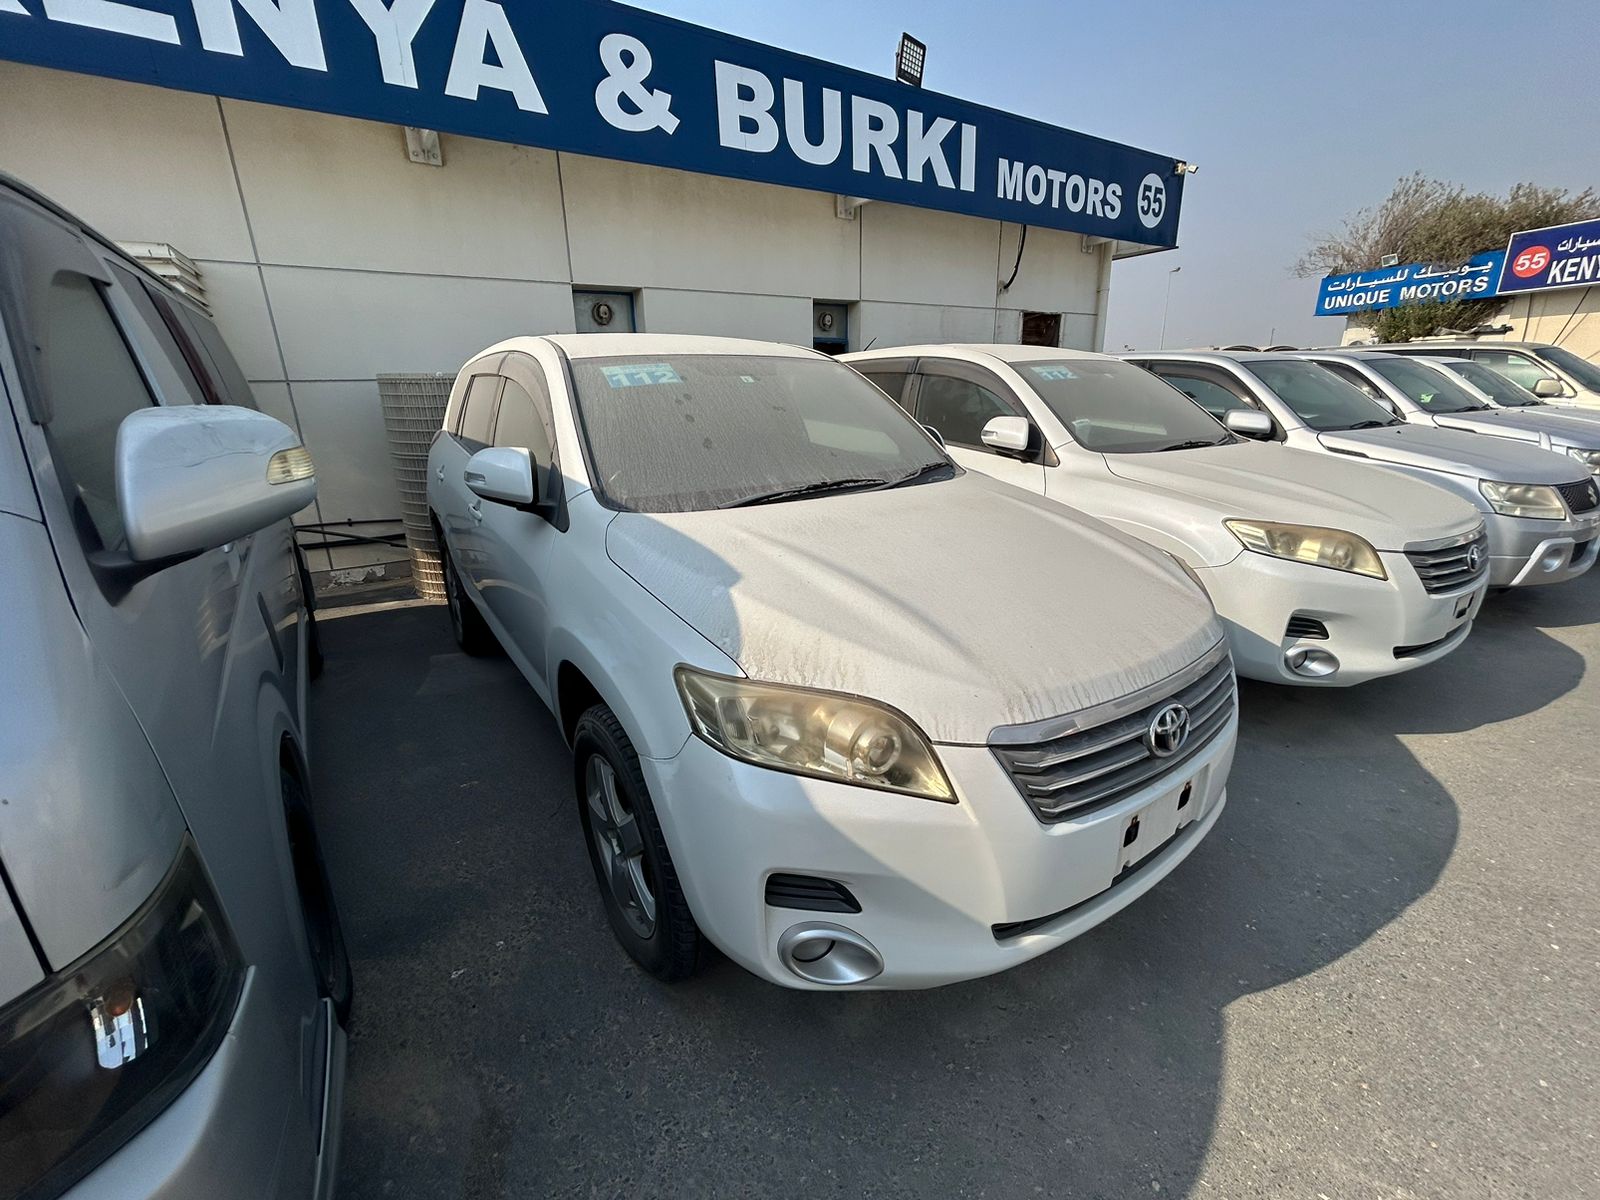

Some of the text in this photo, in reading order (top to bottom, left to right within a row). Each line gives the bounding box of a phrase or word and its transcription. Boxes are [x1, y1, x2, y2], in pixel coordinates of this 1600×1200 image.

[0, 0, 1123, 220] NYA & BURKI MOTORS
[1140, 183, 1164, 218] 55
[1515, 252, 1547, 271] 55
[1546, 254, 1600, 285] KEN
[1324, 276, 1488, 310] UNIQUE MOTORS
[1327, 268, 1409, 292] للسيارات
[612, 371, 681, 387] 112
